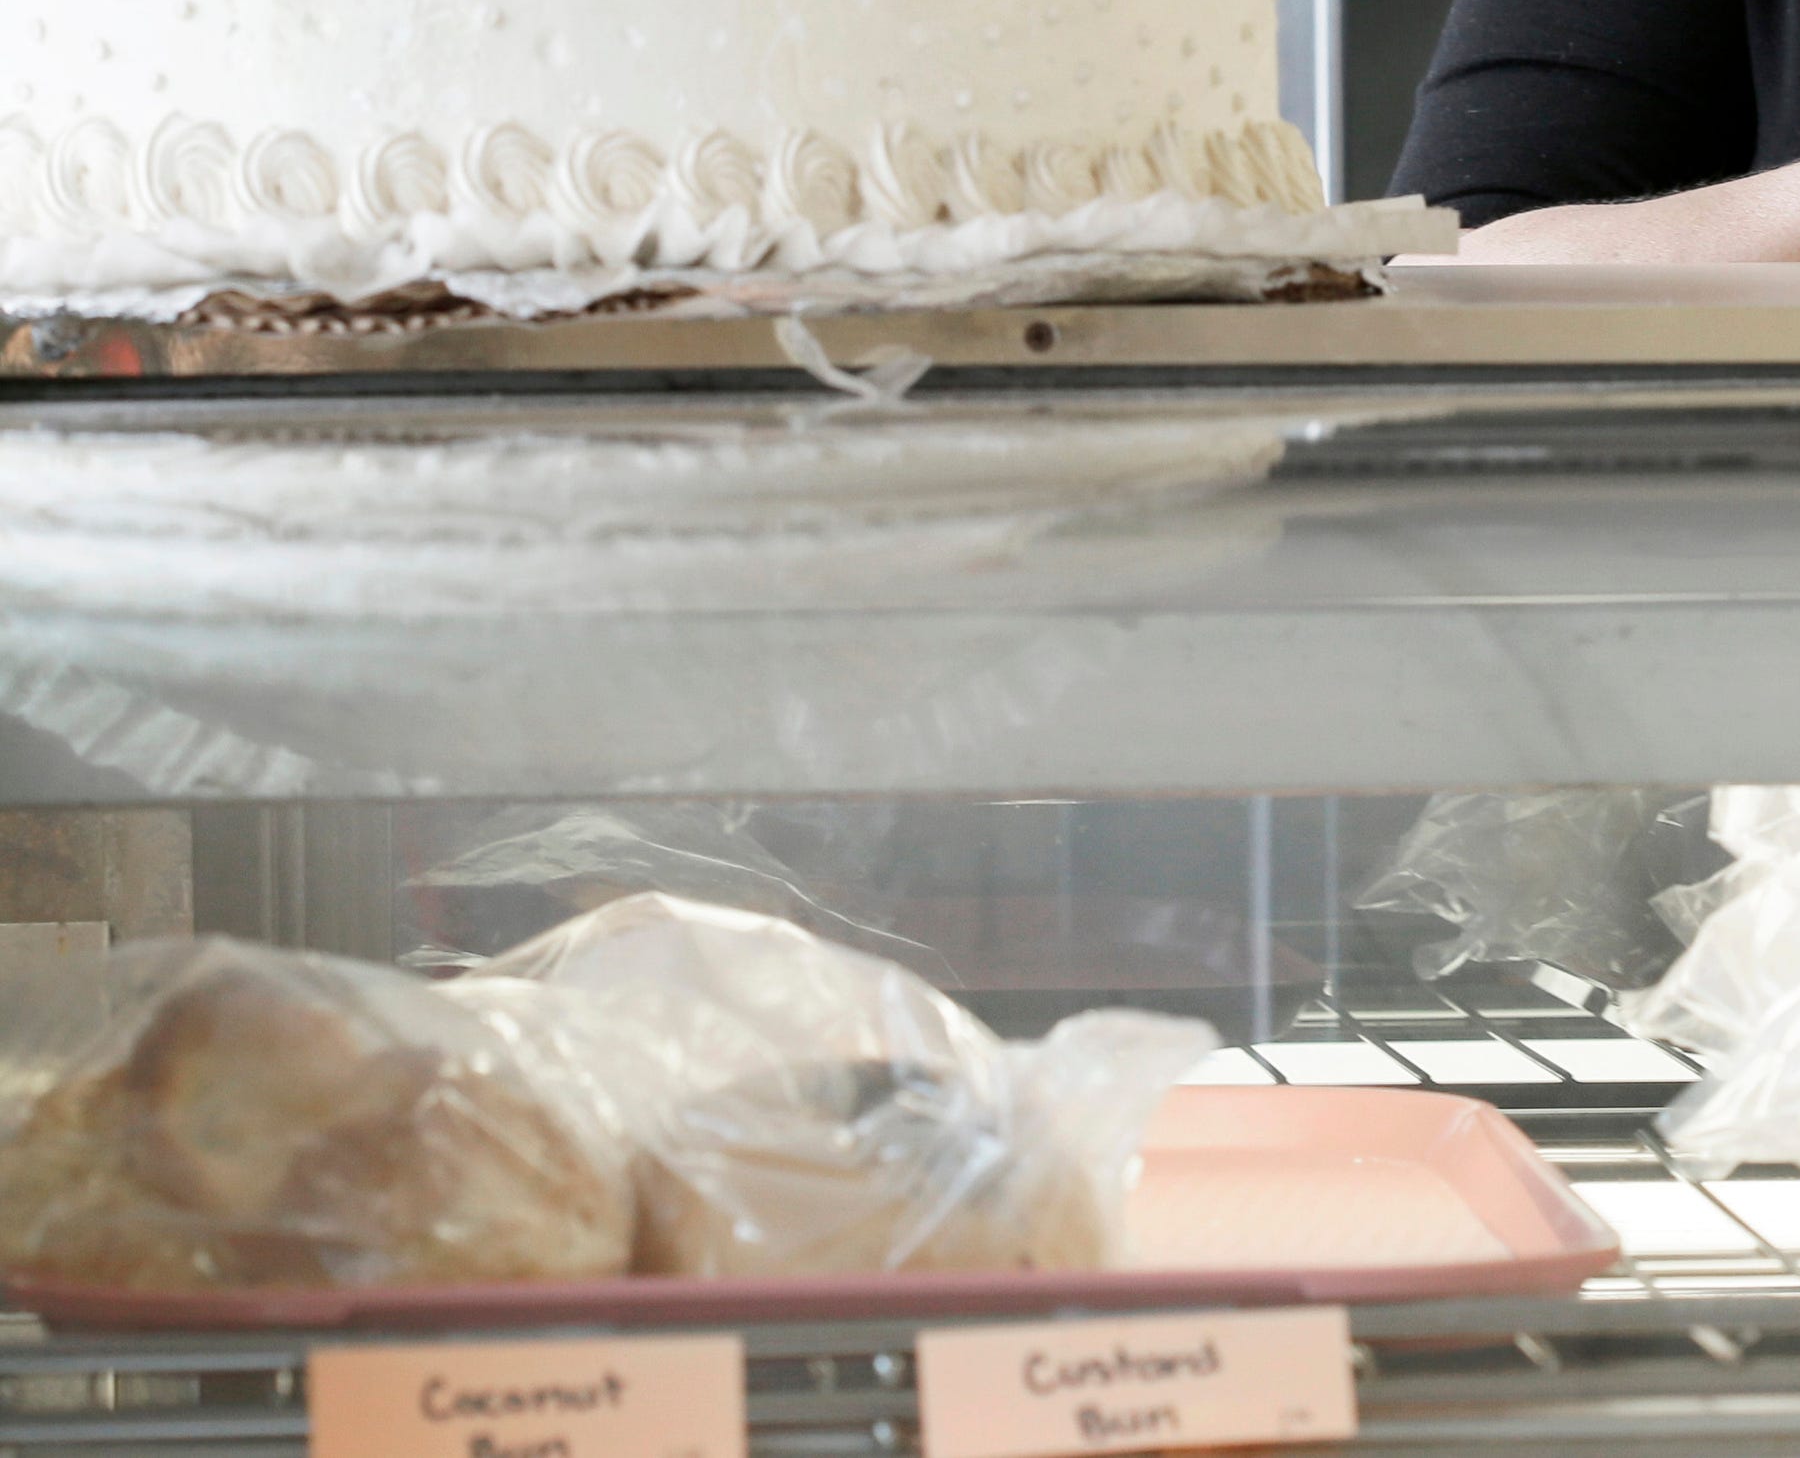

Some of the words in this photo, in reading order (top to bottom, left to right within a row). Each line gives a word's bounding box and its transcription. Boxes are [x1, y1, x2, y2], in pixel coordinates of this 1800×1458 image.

[1023, 1339, 1222, 1395] Custard
[420, 1370, 623, 1422] Coconut
[1076, 1404, 1180, 1441] Bun
